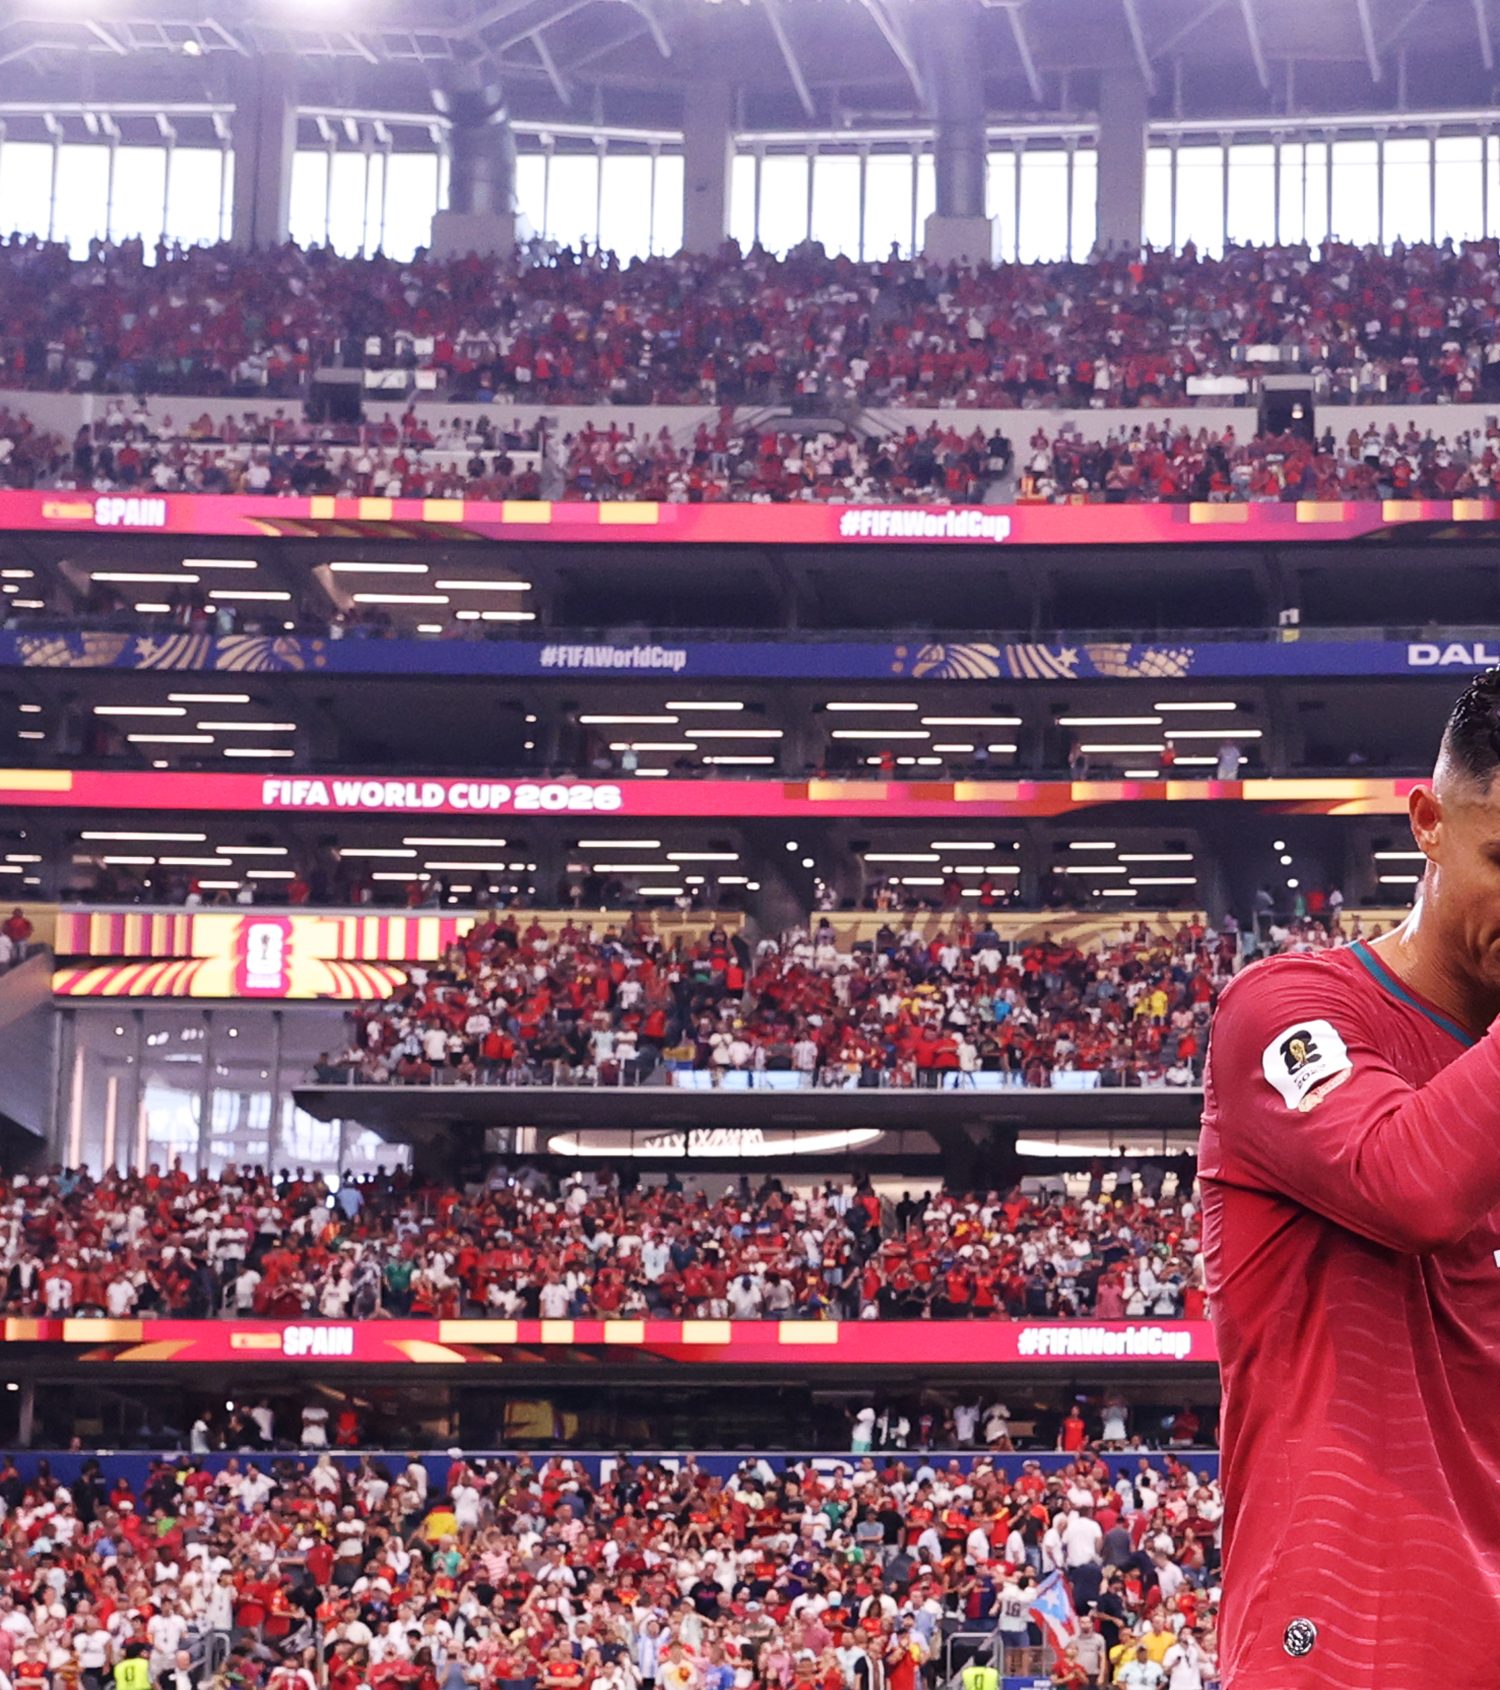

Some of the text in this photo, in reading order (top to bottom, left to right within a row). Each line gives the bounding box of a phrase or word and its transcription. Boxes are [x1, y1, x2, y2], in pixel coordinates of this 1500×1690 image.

[93, 496, 167, 527] SPAIN
[839, 509, 1012, 542] #FIFAWorldCup
[540, 645, 687, 672] #FIFAWorldCup
[262, 779, 622, 811] FIFA WORLD CUP 2026
[282, 1325, 354, 1356] SPAIN
[1016, 1326, 1192, 1360] #FIFAWorldCup
